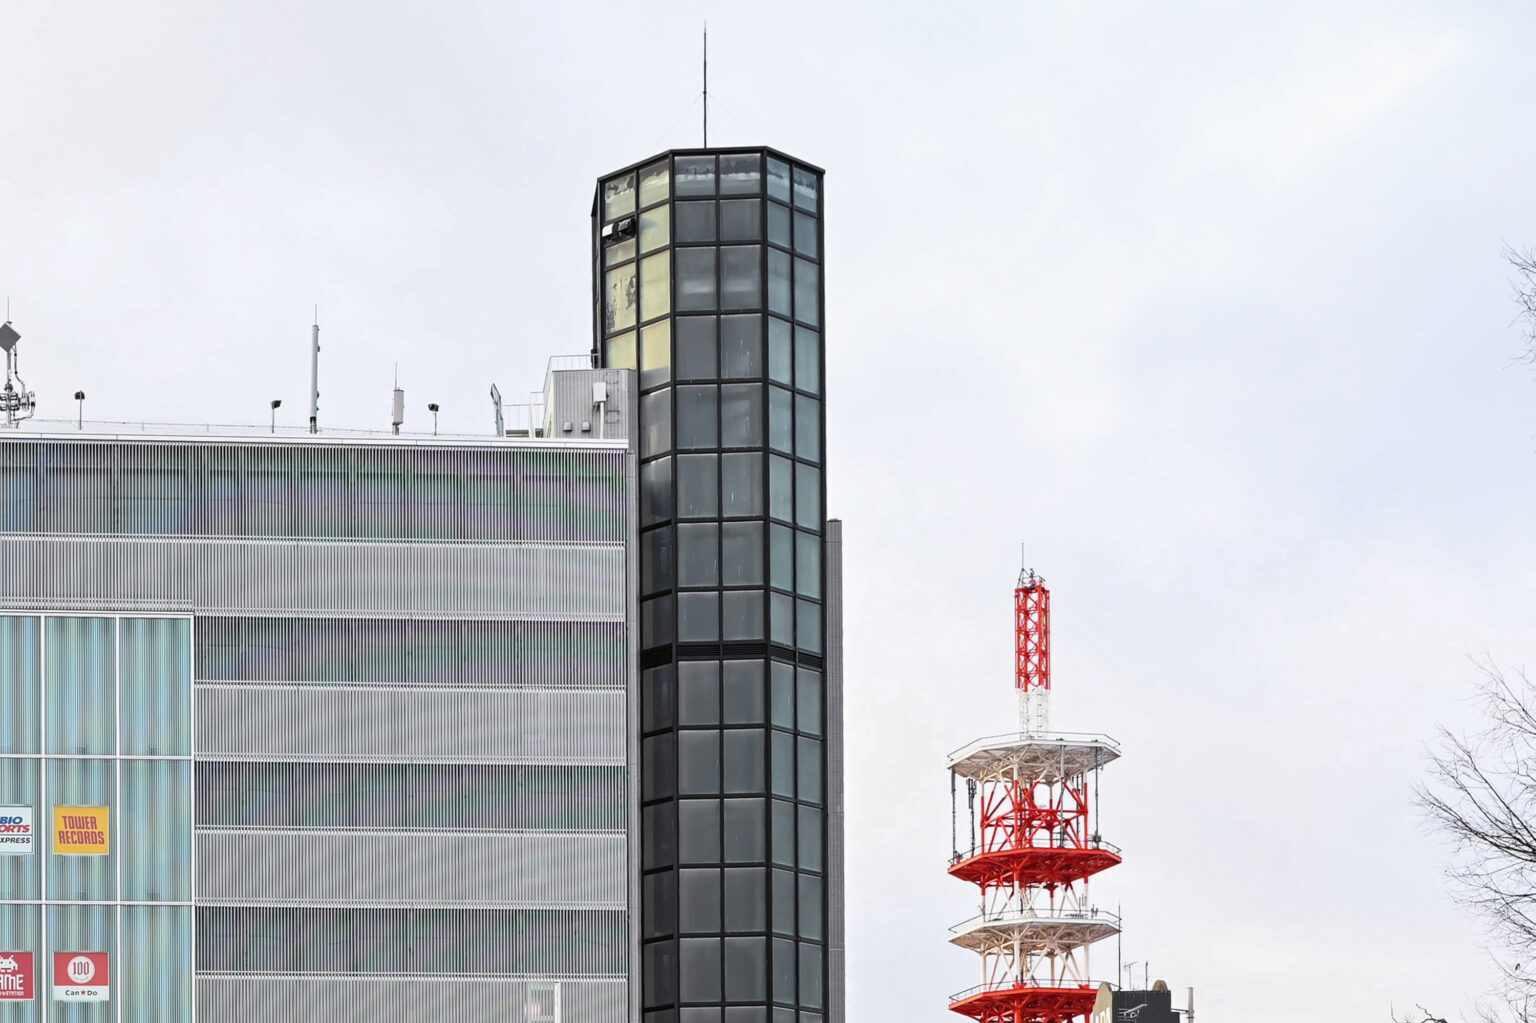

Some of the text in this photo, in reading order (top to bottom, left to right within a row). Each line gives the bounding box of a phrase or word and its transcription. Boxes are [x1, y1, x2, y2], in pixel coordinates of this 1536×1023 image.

[62, 816, 98, 829] TOWER
[58, 831, 105, 845] RECORDS
[73, 961, 90, 975] 100
